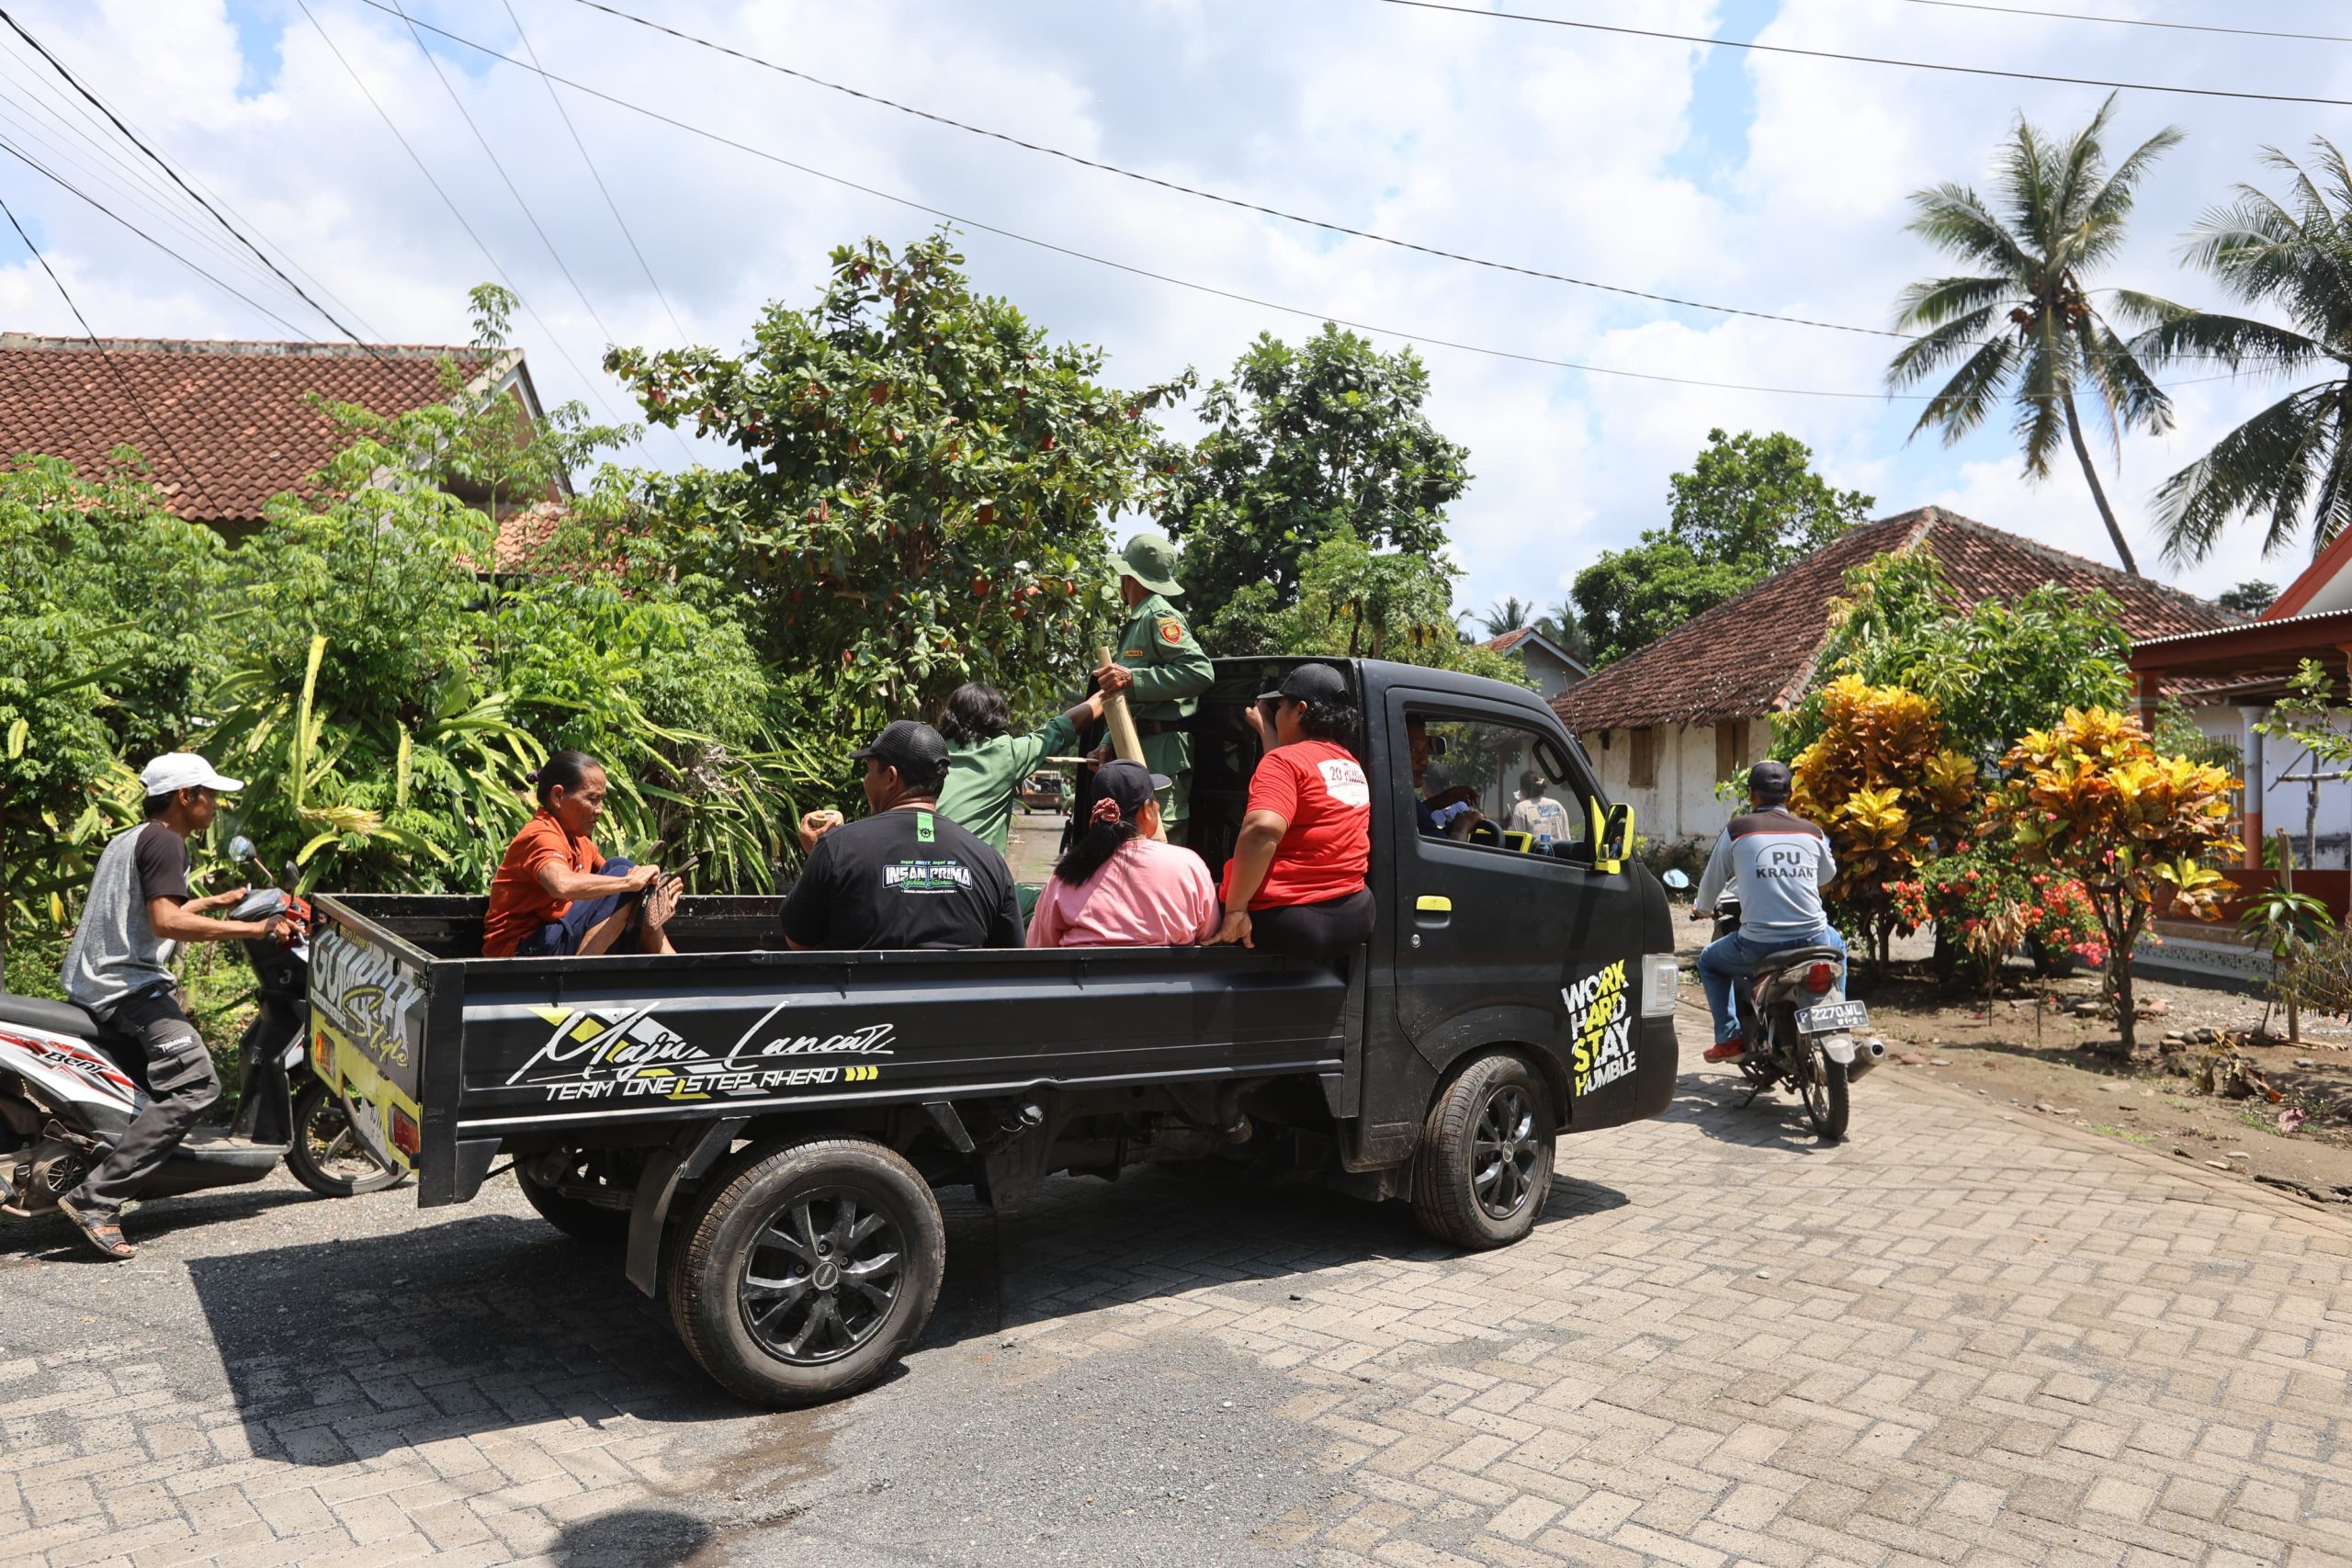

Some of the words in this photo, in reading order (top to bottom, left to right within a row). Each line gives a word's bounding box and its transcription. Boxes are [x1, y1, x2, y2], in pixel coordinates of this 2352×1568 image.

[1329, 766, 1342, 781] 20
[1772, 852, 1801, 865] PU
[886, 866, 926, 885] INSAN
[930, 867, 970, 886] PRIMA
[1756, 867, 1814, 879] KRAJAN
[1561, 959, 1630, 1013] WORK
[1571, 991, 1627, 1041] HARD
[1800, 1011, 1808, 1023] P
[1811, 1006, 1843, 1021] 2270
[1571, 1016, 1632, 1073] STAY
[546, 1081, 615, 1101] TEAM
[623, 1077, 675, 1097] ONE
[682, 1072, 752, 1093] STEP
[761, 1066, 839, 1088] AHEAD
[1575, 1050, 1637, 1098] HUMBLE
